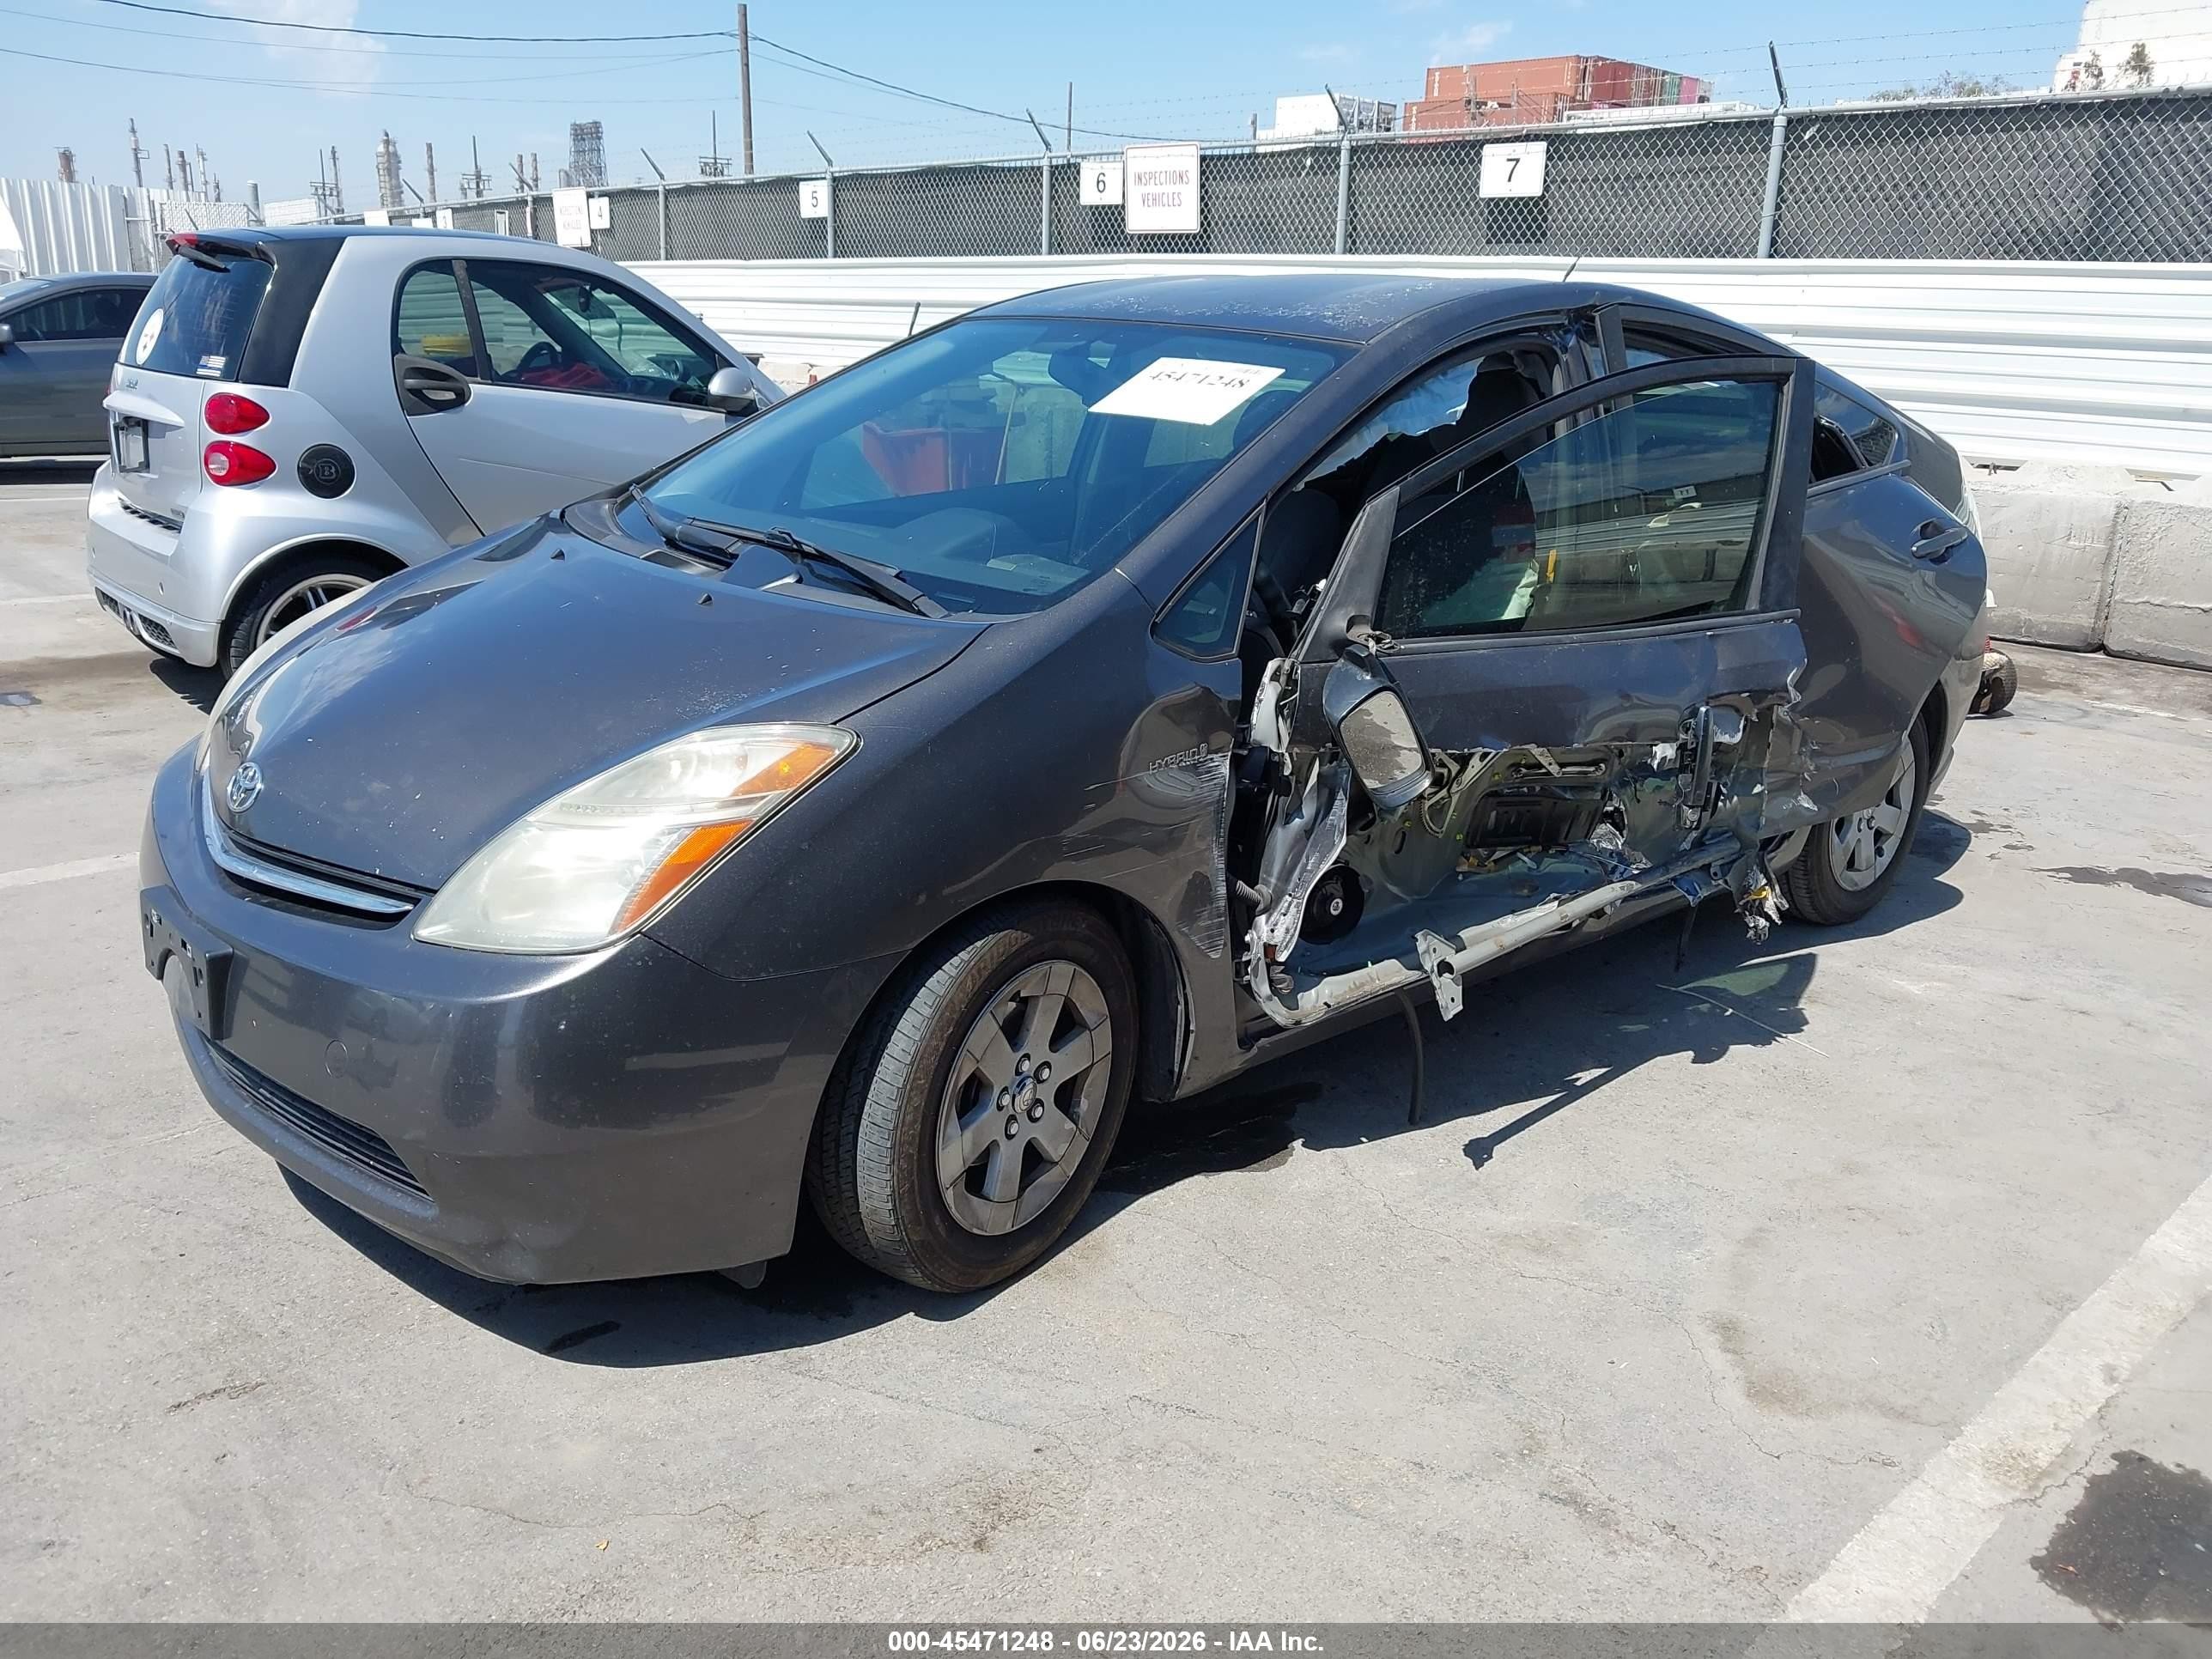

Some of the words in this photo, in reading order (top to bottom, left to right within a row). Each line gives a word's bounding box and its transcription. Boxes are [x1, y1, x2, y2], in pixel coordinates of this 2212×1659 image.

[1133, 170, 1190, 186] INSPECTIONS
[1506, 157, 1521, 183] 7
[1096, 172, 1106, 193] 6
[811, 190, 818, 208] 5
[1141, 191, 1182, 208] VEHICLES
[597, 205, 603, 221] 4
[1149, 370, 1250, 388] 45471248
[1149, 747, 1199, 775] HYBRID
